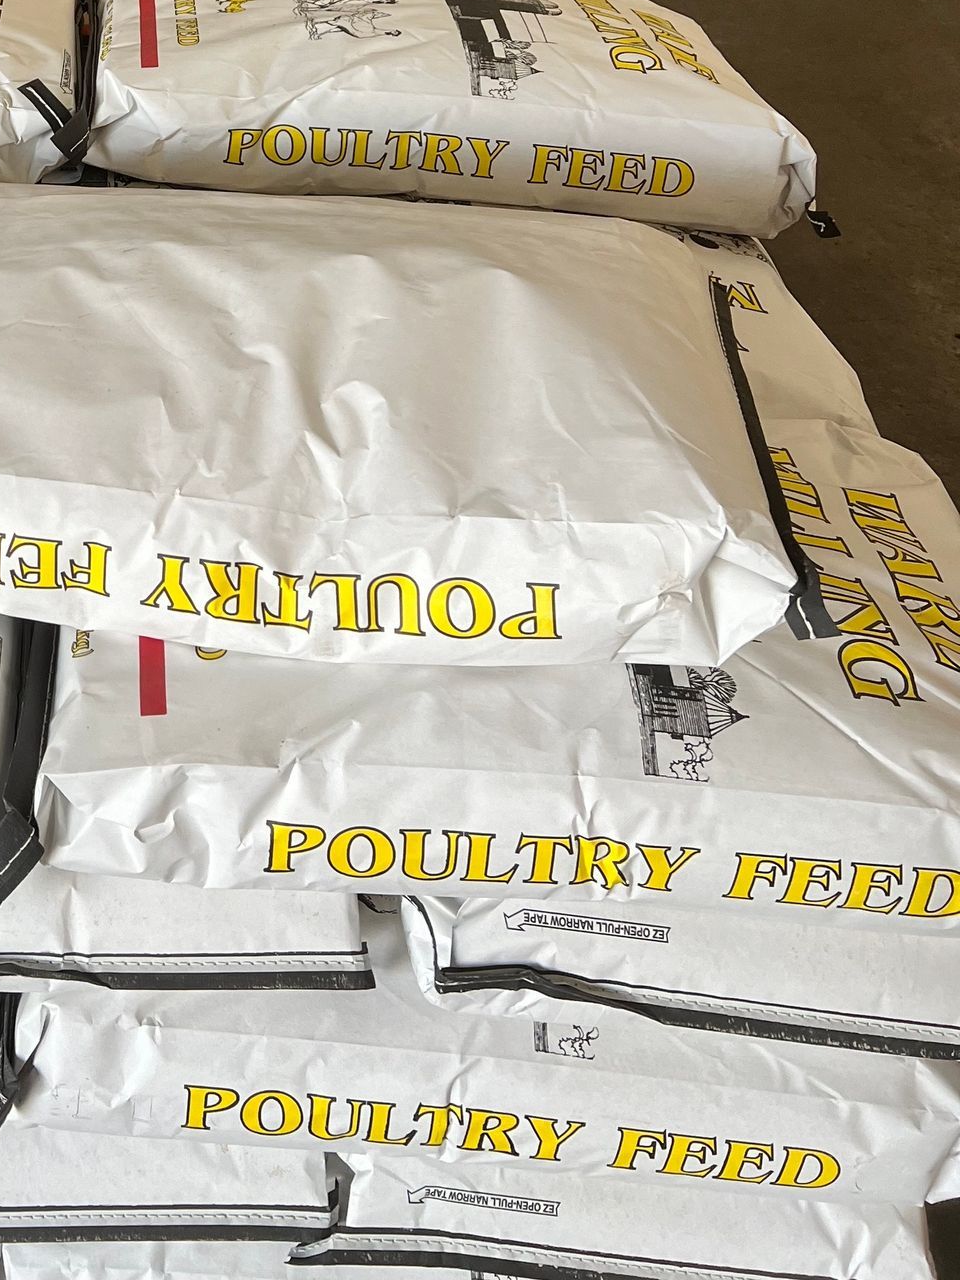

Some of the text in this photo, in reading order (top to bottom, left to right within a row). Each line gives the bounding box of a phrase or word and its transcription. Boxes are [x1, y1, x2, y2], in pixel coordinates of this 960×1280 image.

[175, 17, 201, 47] FEED
[225, 122, 696, 199] POULTRY FEED
[140, 553, 562, 641] POULTRY
[767, 445, 928, 707] MILLING
[262, 820, 960, 921] POULTRY FEED
[523, 912, 665, 940] EZ OPEN-PULL NARROW TAPE
[181, 1083, 842, 1189] POULTRY FEED
[424, 1188, 555, 1214] EZ OPEN-PULL NARROW TAPE
